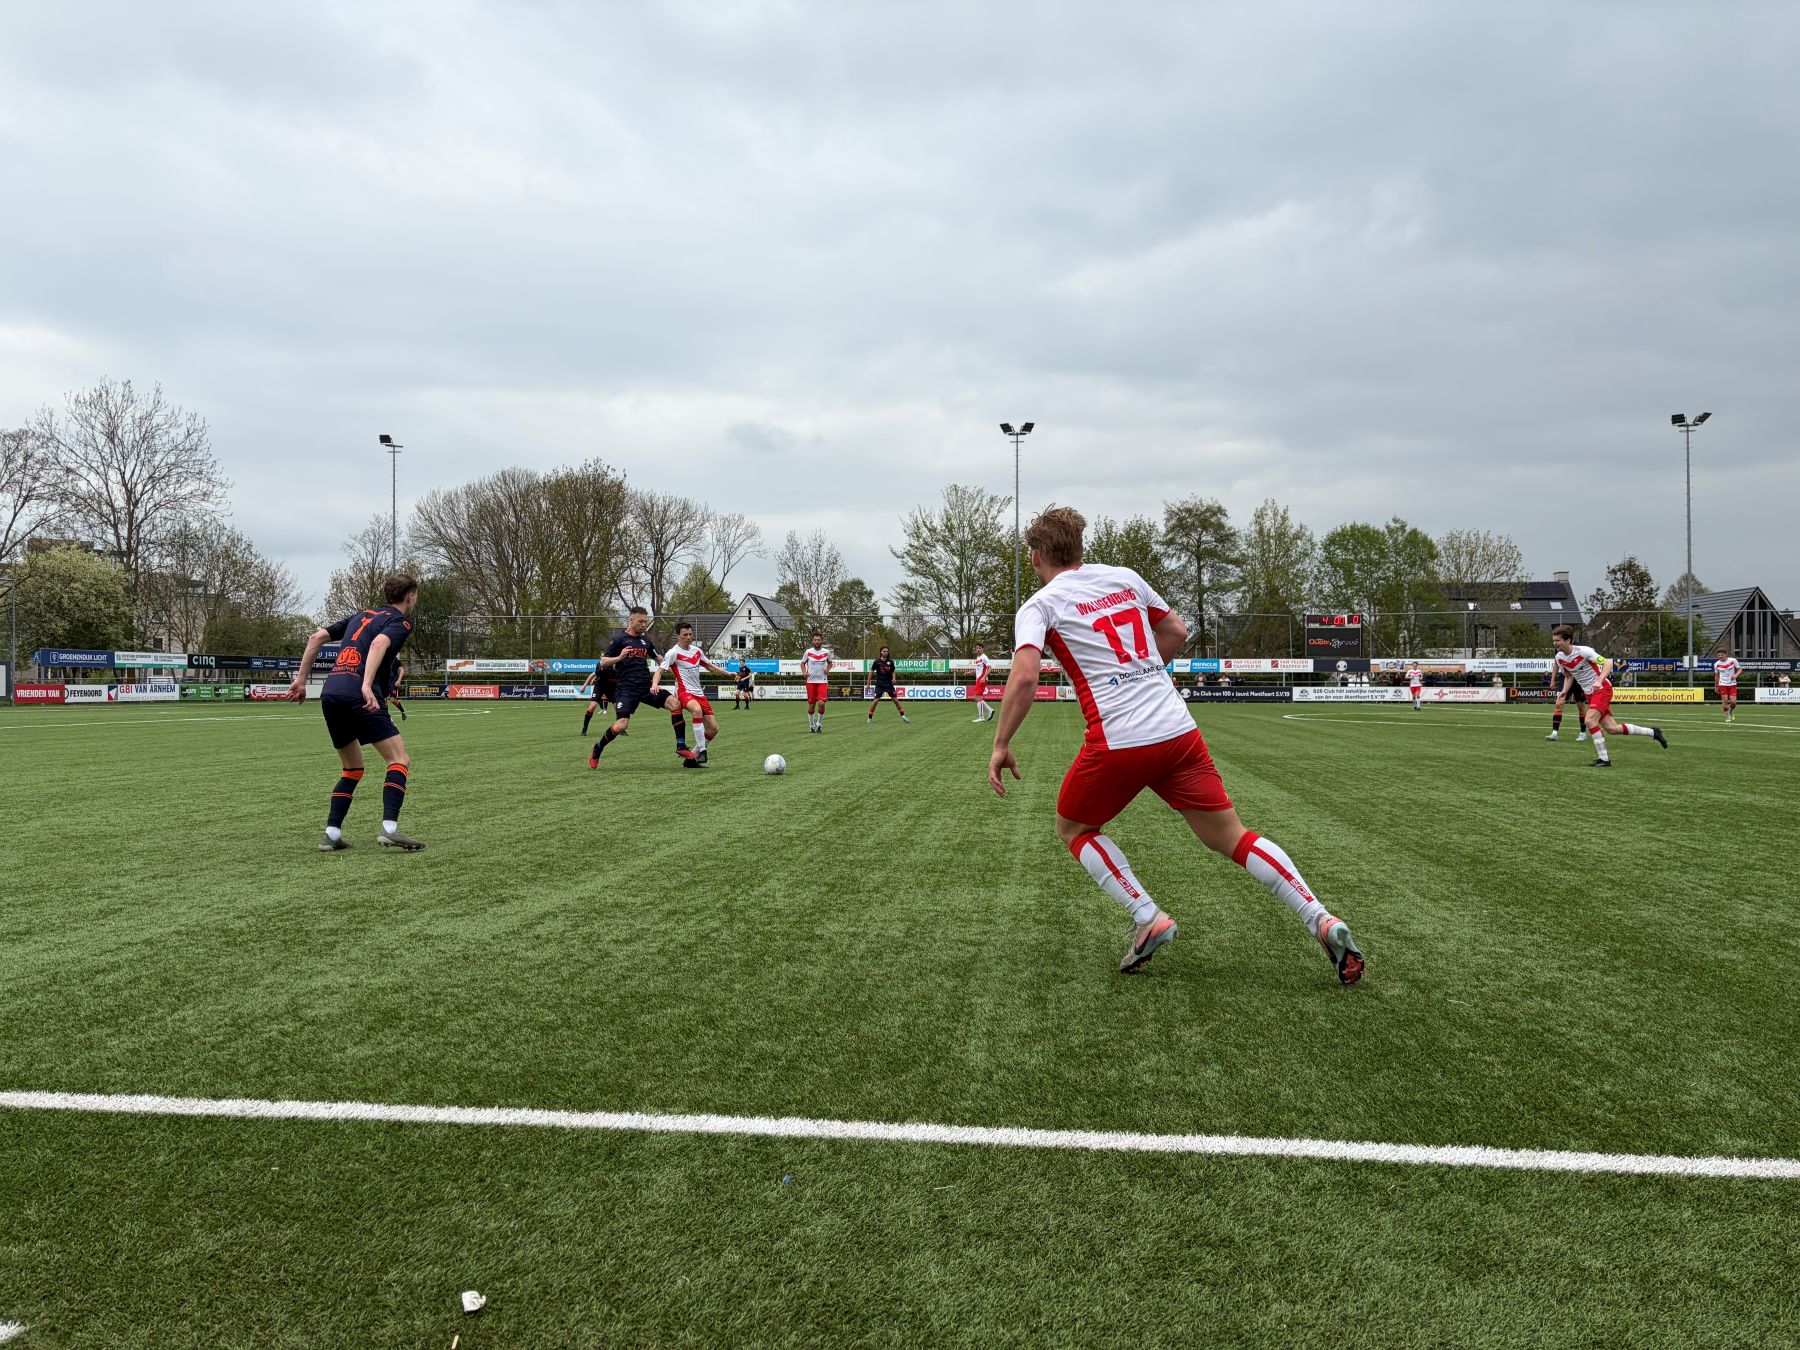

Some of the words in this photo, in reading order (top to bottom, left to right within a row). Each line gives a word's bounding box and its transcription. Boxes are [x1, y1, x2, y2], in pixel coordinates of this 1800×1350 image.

[1076, 588, 1137, 616] WILLIGENBURG
[351, 617, 373, 641] 7
[1092, 607, 1149, 664] 17
[192, 656, 216, 668] cinq
[895, 660, 929, 668] LARPROF
[1515, 660, 1548, 669] veenbrink
[16, 690, 47, 699] VRIENDEN
[48, 690, 60, 698] VAN
[70, 690, 103, 698] FEYENOORD
[119, 685, 133, 694] GBI
[134, 685, 148, 695] VAN
[149, 685, 176, 695] ARNHEM
[907, 687, 952, 698] draads
[1614, 693, 1695, 702] www.mobipoint.nl
